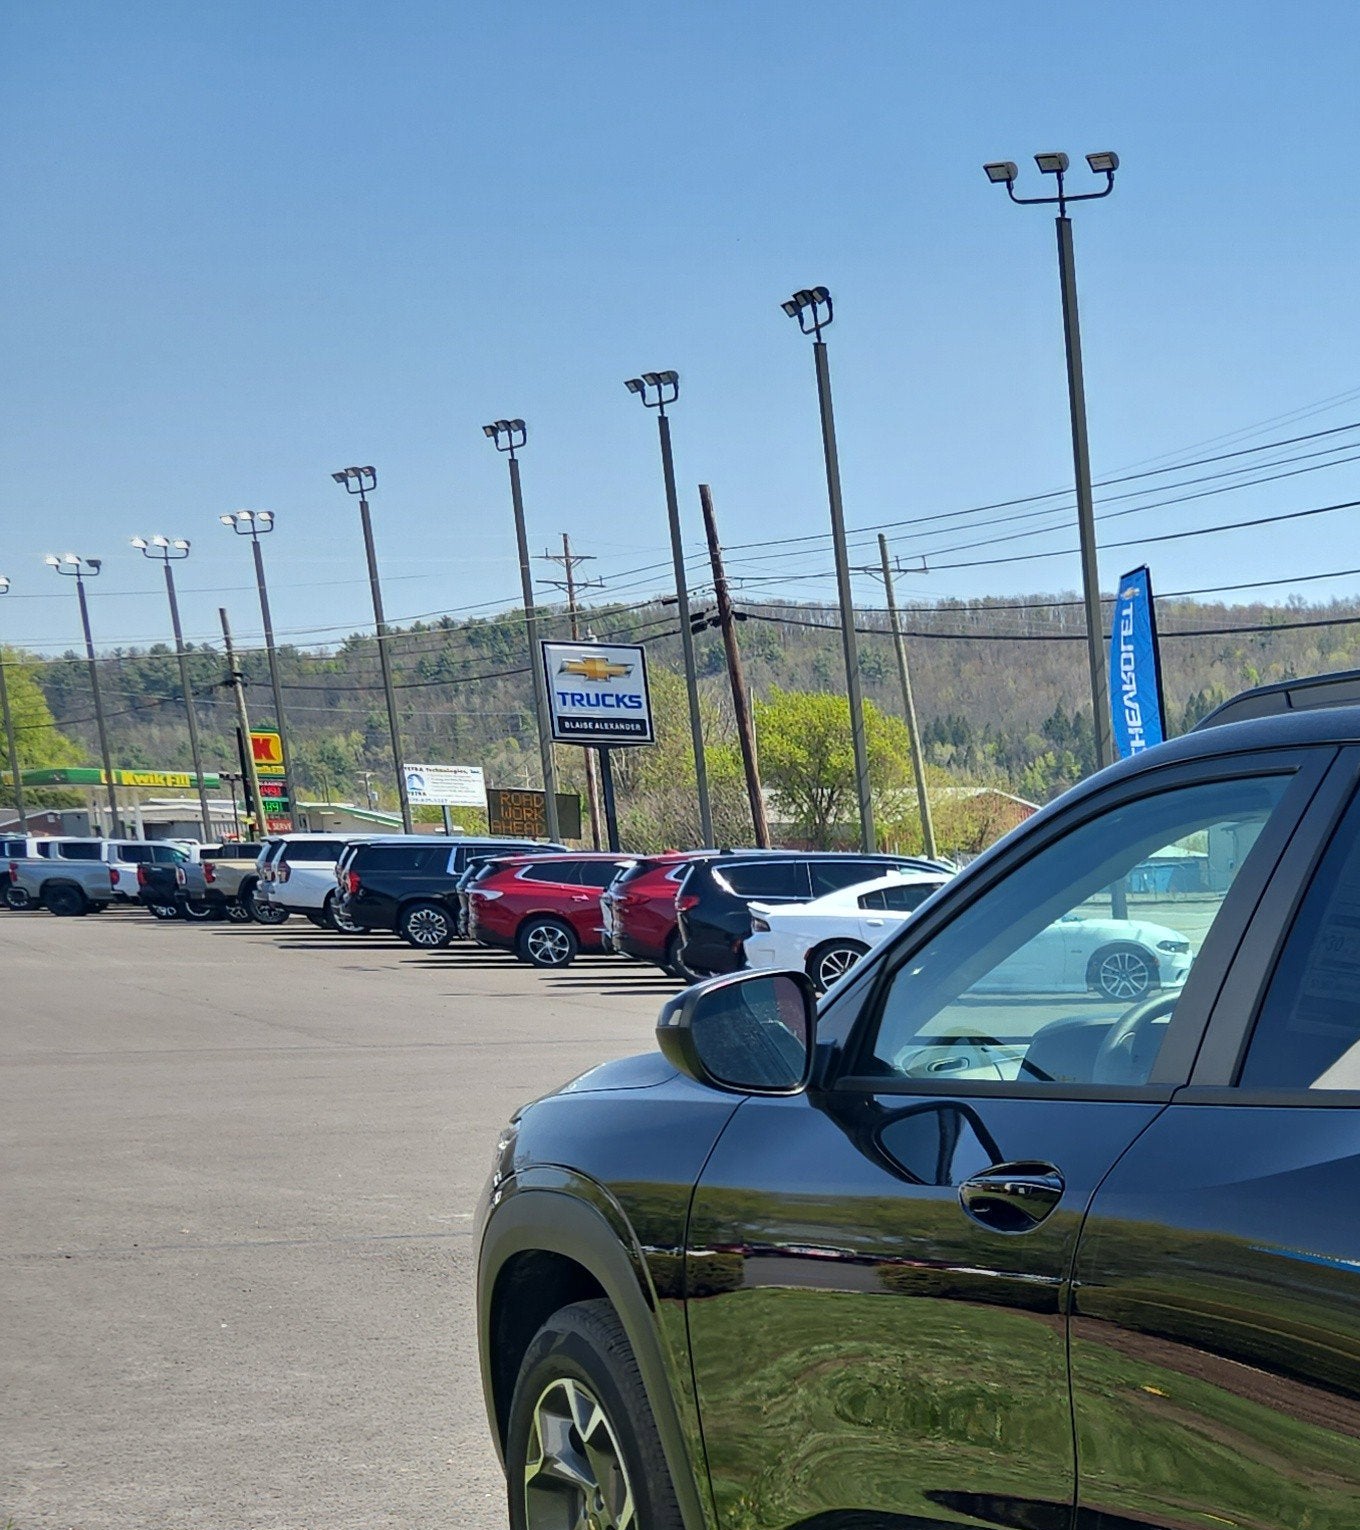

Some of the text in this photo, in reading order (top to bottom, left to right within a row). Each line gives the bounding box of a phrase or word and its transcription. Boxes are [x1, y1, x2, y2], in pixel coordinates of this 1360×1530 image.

[556, 691, 643, 710] TRUCKS
[564, 721, 642, 732] BLAISE ALEXANDER
[121, 769, 191, 788] Kwik Fill
[500, 791, 545, 808] ROAD
[501, 806, 545, 822] WORK
[490, 820, 547, 836] AHEAD
